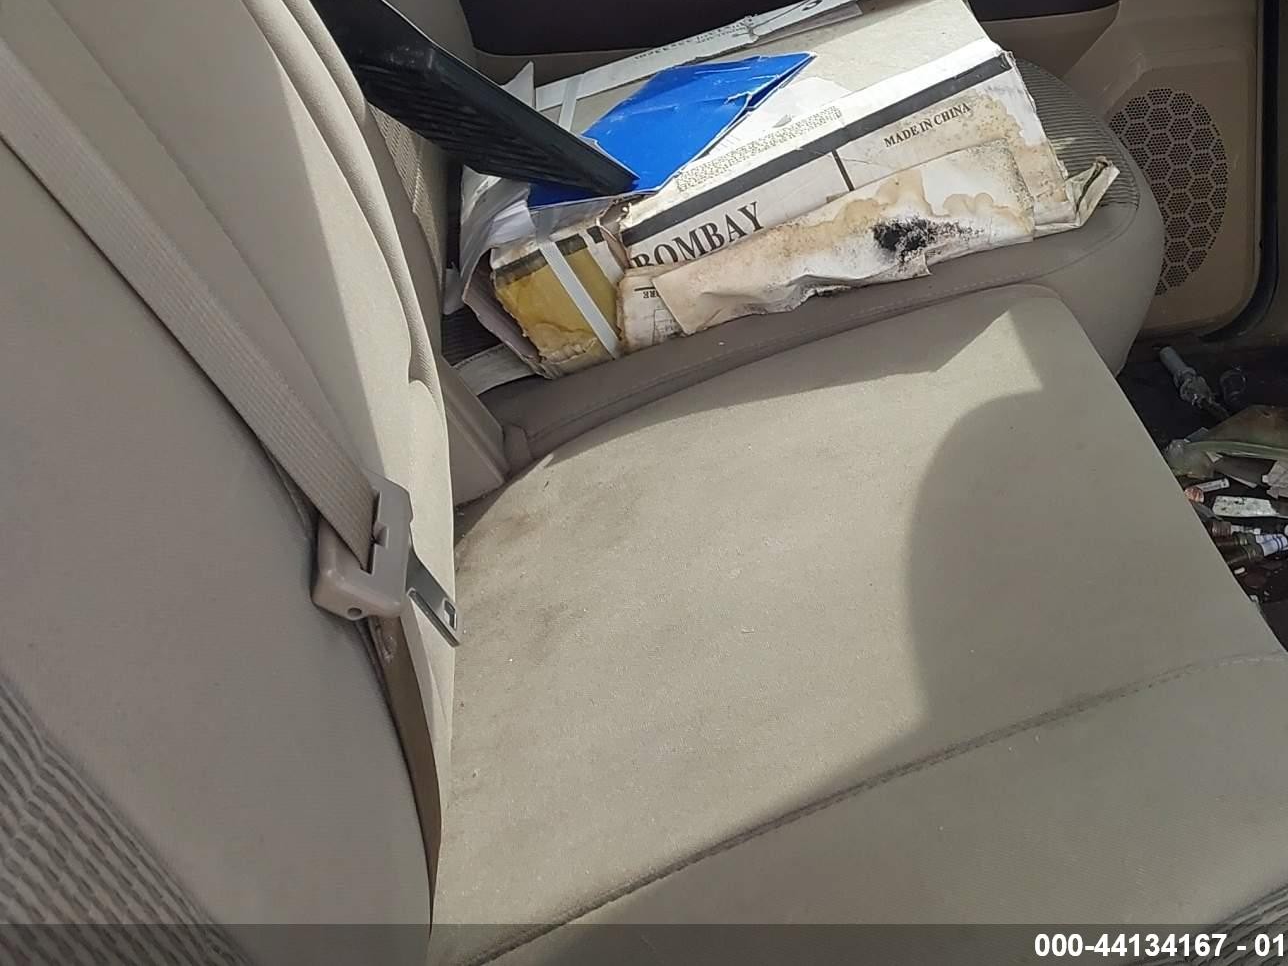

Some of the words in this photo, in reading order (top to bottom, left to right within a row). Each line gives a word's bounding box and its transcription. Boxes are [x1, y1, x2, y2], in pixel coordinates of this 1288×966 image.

[883, 125, 920, 148] MADE
[919, 118, 934, 132] IN
[933, 102, 972, 126] CHINA
